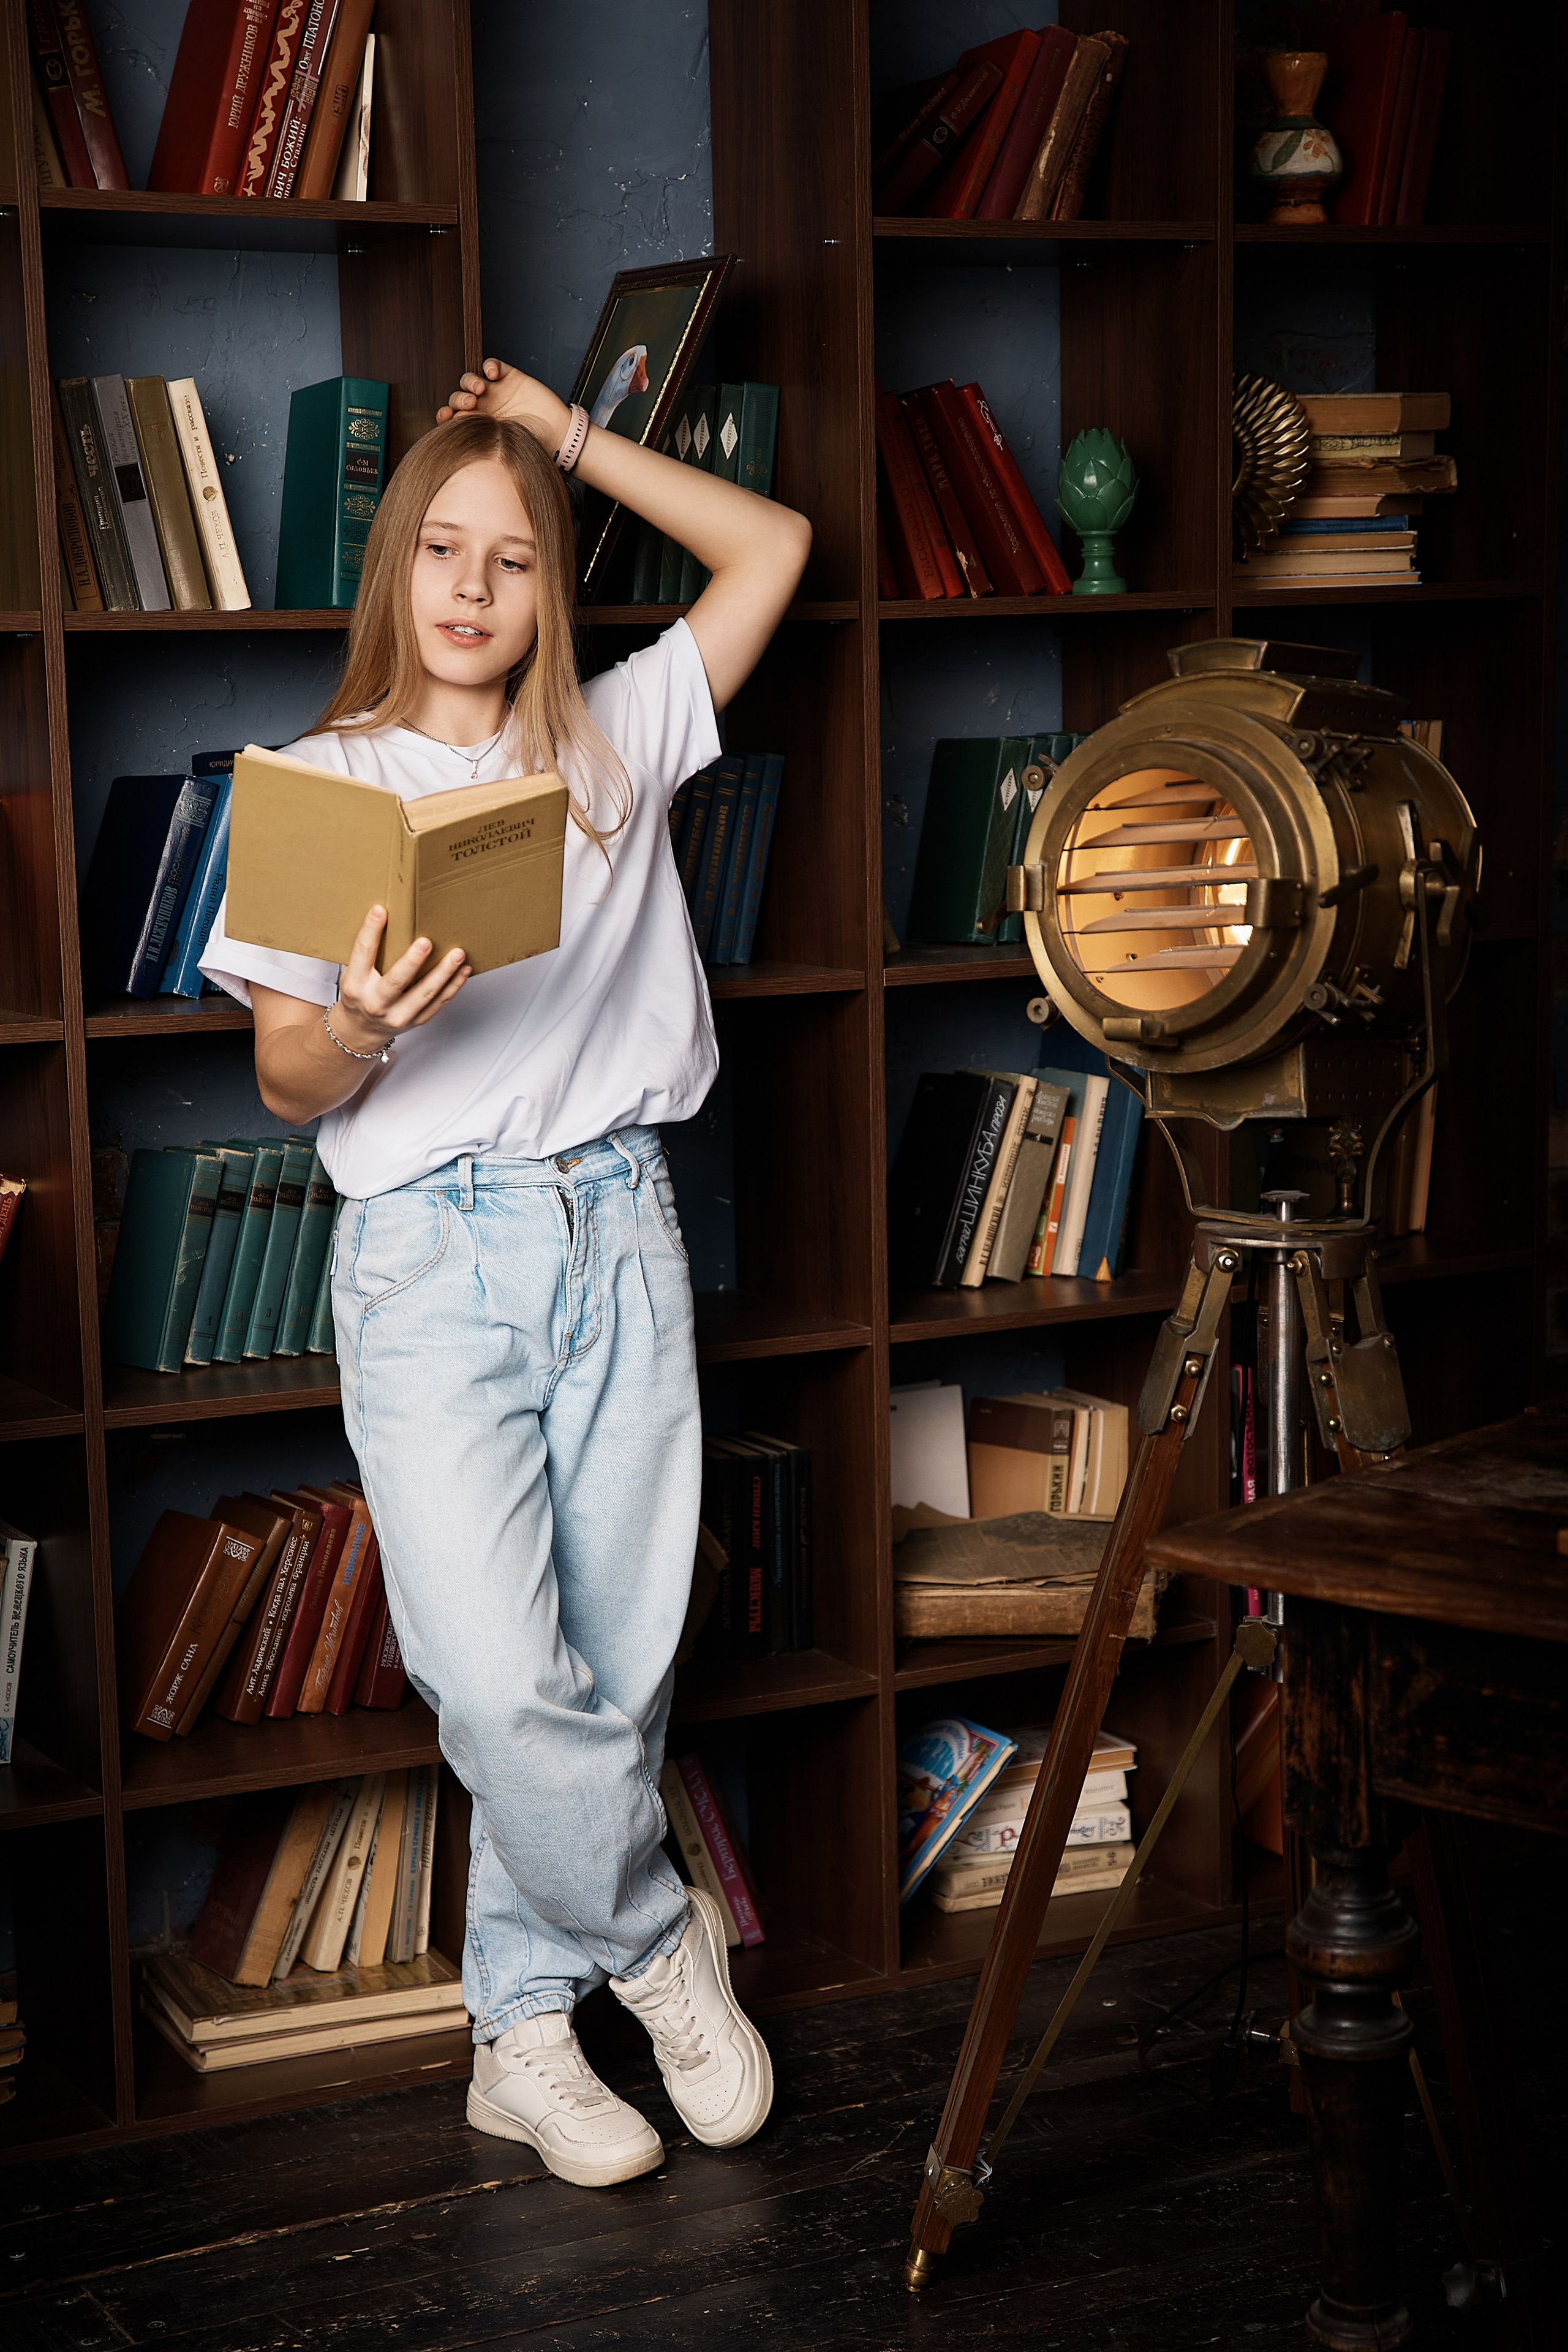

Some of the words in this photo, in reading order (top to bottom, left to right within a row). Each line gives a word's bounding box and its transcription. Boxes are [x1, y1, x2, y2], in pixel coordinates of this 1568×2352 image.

[233, 24, 258, 94] ДРУЖНИКОВ
[296, 49, 313, 70] Олег
[226, 94, 244, 129] ЮРИЙ
[273, 172, 287, 198] БИЧ
[280, 116, 301, 168] БОЖИЙ:
[289, 122, 307, 168] Сталина
[914, 415, 935, 450] ТВЕН
[194, 445, 208, 478] Повести
[345, 464, 379, 475] СОЛОВЬЕВ
[928, 453, 949, 489] МАРК
[988, 487, 998, 499] по
[903, 502, 934, 578] РАССКАЗЫ
[993, 500, 1022, 554] Хрестоматия
[448, 818, 536, 851] НИКОЛАЕВИЧ
[450, 826, 532, 861] ТОЛСТОЙ
[477, 819, 505, 833] ЛЕВ
[207, 872, 224, 903] Радий
[196, 905, 214, 947] Погодин
[957, 1130, 997, 1224] ШИНКУБА
[989, 1093, 1008, 1132] ПРОЗА
[752, 1475, 761, 1517] СТИВЕН
[342, 1522, 366, 1585] ИЗБРАННОЕ
[751, 1518, 761, 1550] КИНГ
[281, 1536, 298, 1576] Херсонес
[292, 1540, 311, 1581] Франции
[307, 1578, 323, 1610] Галина
[317, 1527, 337, 1577] Николаева
[275, 1576, 287, 1593] пал
[280, 1581, 297, 1621] королева
[748, 1566, 762, 1633] МОНСТРЫ
[6, 1621, 20, 1673] САМОУЧИТЕЛЬ
[17, 1546, 29, 1571] ЯЗЫКА
[268, 1593, 282, 1618] Когда
[251, 1626, 271, 1675] Ладинский
[263, 1627, 284, 1672] Ярославна
[164, 1673, 184, 1704] ЖОРЖ
[179, 1641, 198, 1671] САНД
[246, 1674, 257, 1695] Ант.
[257, 1672, 270, 1696] Анна
